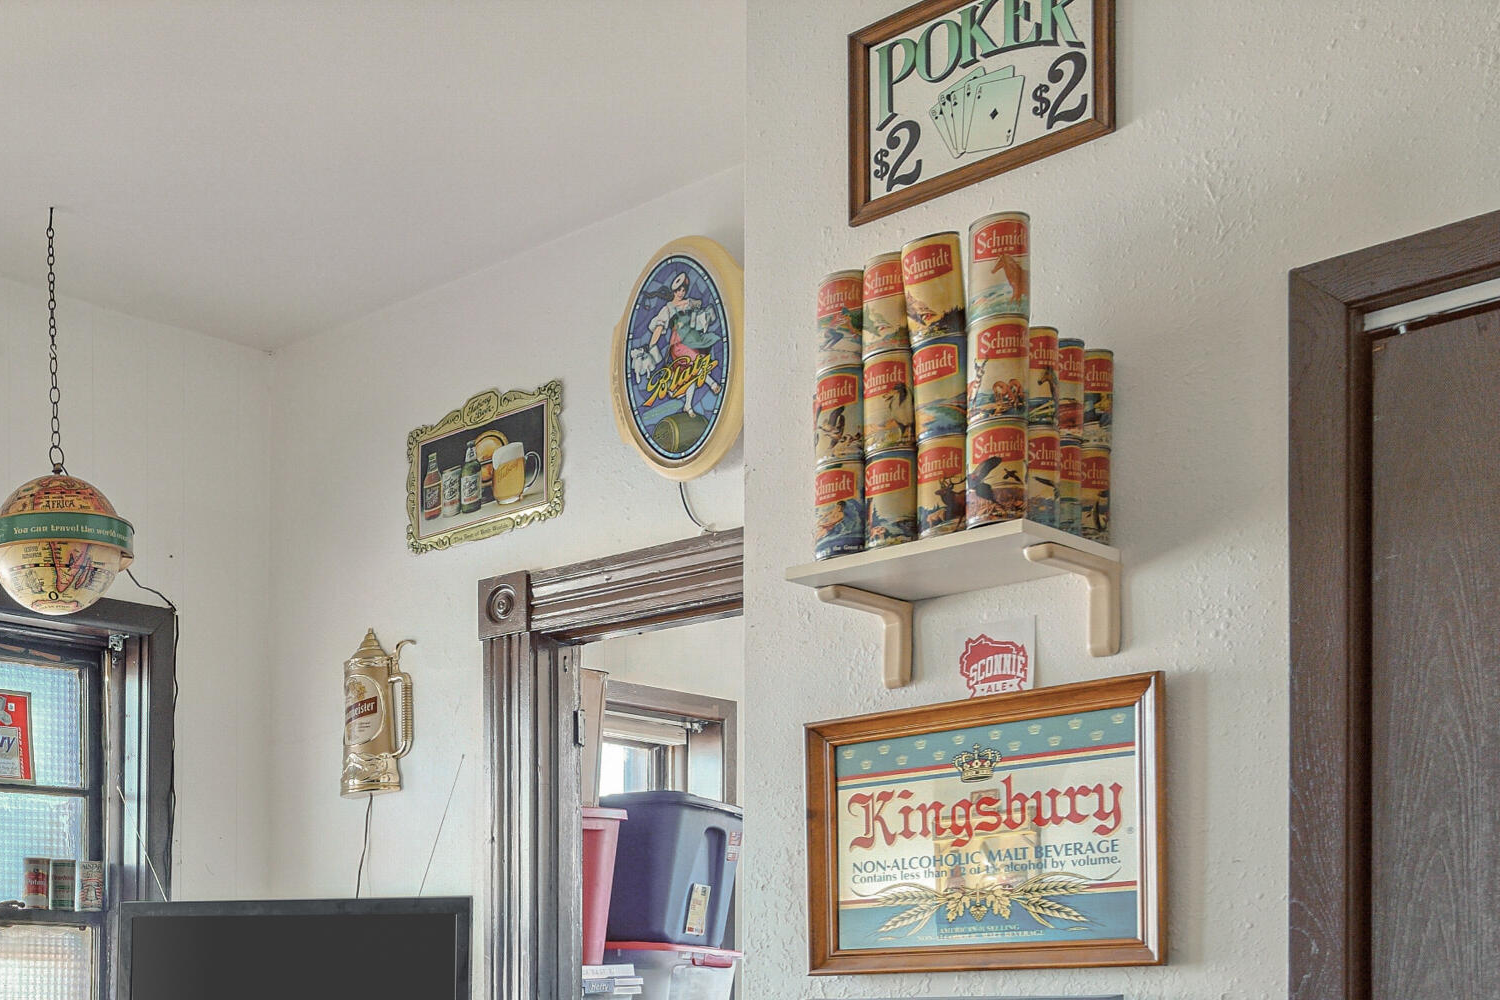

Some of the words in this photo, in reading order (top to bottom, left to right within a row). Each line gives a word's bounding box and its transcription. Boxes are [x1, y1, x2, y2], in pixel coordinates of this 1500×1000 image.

[1032, 51, 1088, 130] $2
[873, 119, 923, 192] $2
[903, 247, 949, 281] Schmidt
[643, 353, 719, 407] Blatz
[974, 435, 1025, 460] Schmidt
[45, 499, 75, 510] AFRICA
[14, 526, 29, 535] You
[51, 524, 79, 533] travel
[969, 653, 1026, 686] SCONNIE
[986, 682, 1007, 694] ALE
[847, 774, 1124, 851] Kingsbury
[851, 873, 898, 884] Contains
[900, 870, 921, 881] less
[924, 867, 948, 879] than
[1004, 858, 1048, 873] alcohol
[1051, 857, 1066, 871] by
[1070, 852, 1121, 868] volume.
[852, 851, 981, 874] NON-ALCOHOLIC
[988, 845, 1029, 862] MALT
[1034, 838, 1120, 859] BEVERAGE
